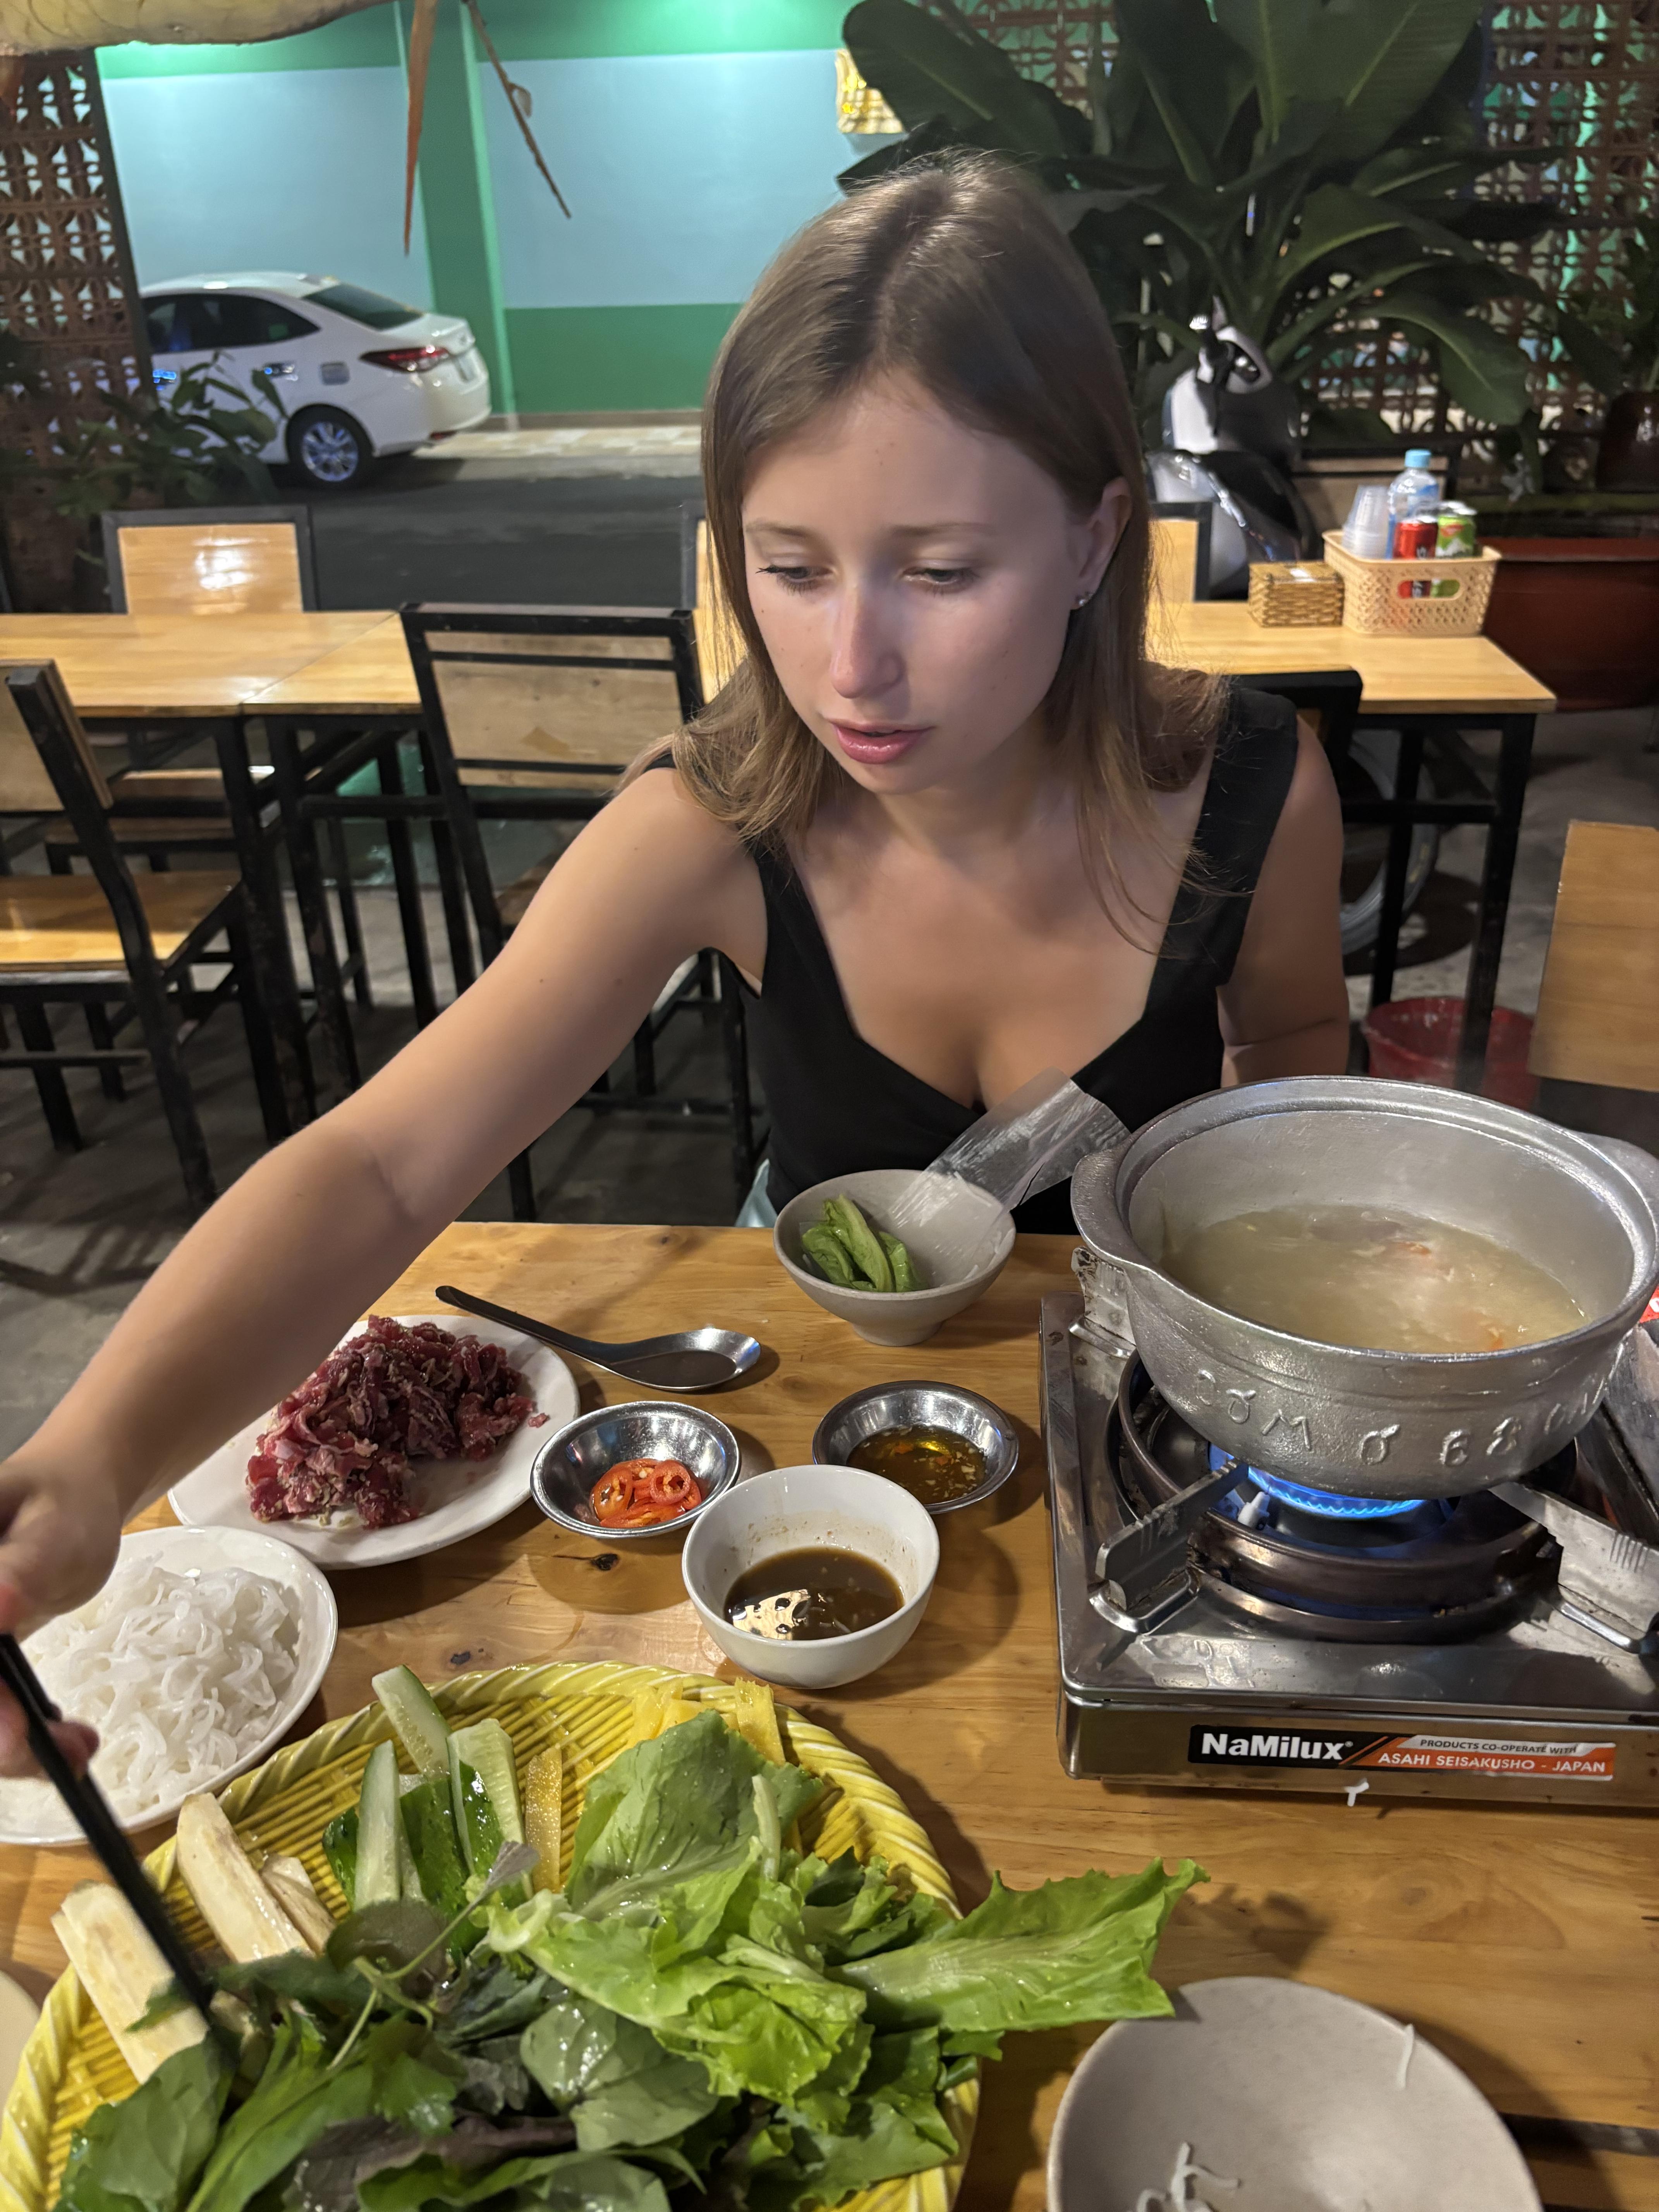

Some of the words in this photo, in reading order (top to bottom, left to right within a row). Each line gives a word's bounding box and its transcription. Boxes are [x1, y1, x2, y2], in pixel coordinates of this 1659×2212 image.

[1420, 1739, 1479, 1750] PRODUCTS
[1482, 1743, 1546, 1753] CO-OPERATE
[1550, 1746, 1577, 1755] WITH
[1378, 1753, 1430, 1765] ASAHI
[1436, 1755, 1535, 1770] SEISAKUSHO
[1552, 1761, 1605, 1772] JAPAN
